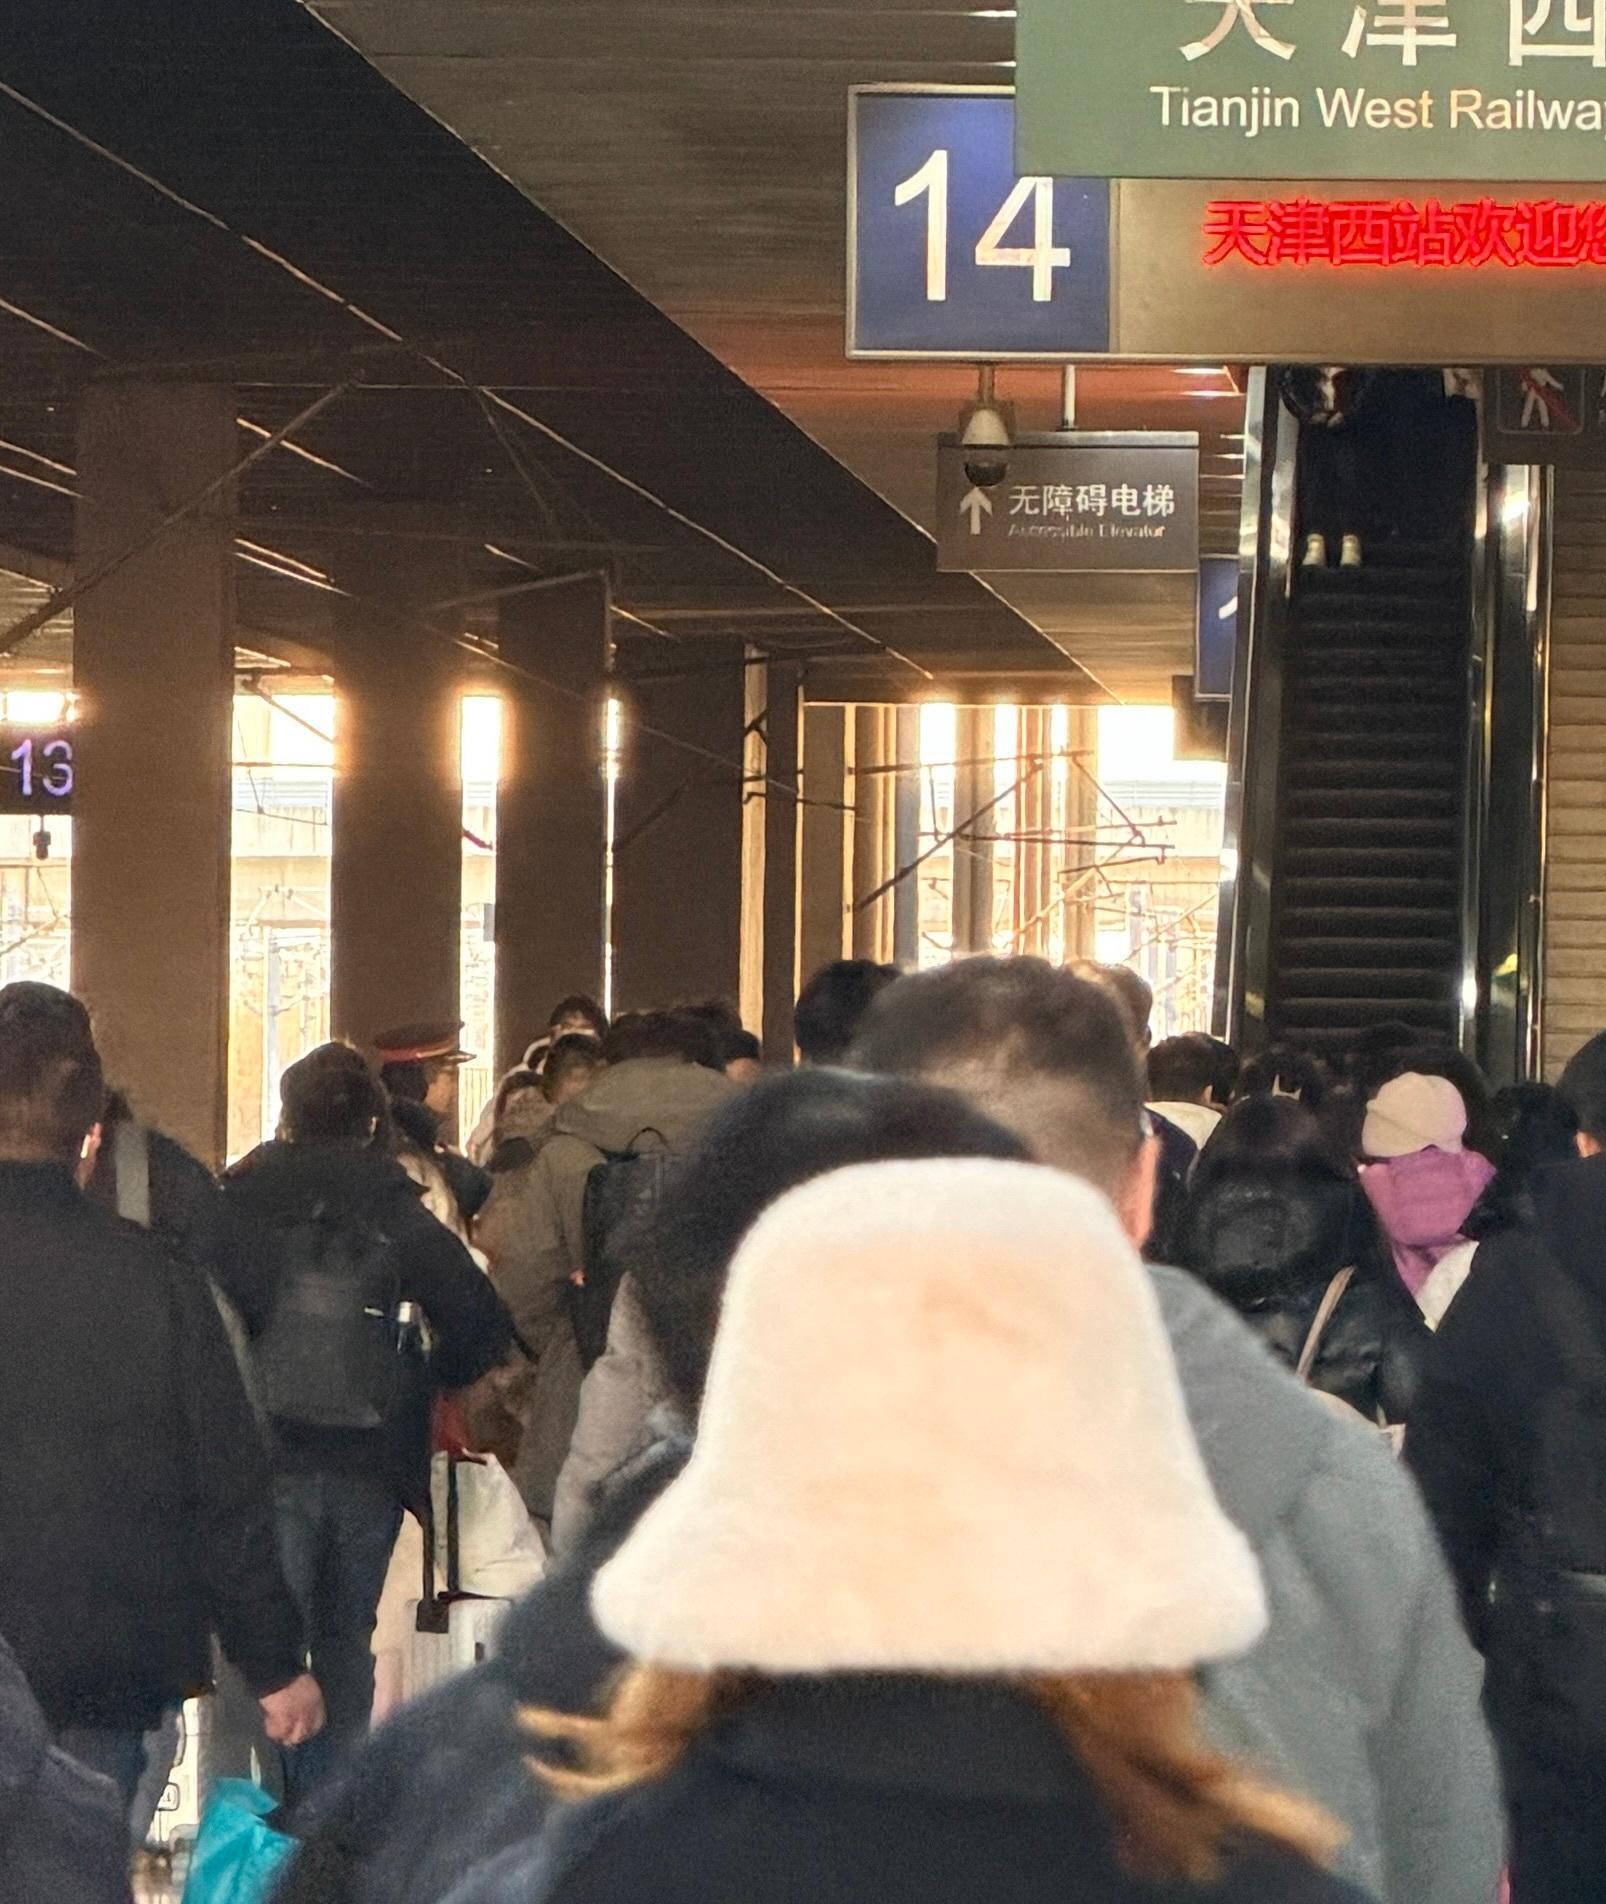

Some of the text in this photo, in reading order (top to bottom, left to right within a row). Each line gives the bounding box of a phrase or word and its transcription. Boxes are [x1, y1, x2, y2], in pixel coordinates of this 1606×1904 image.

[1149, 86, 1300, 138] Tianjin
[1315, 86, 1434, 129] West
[894, 148, 1072, 302] 14
[1008, 483, 1176, 518] 无障碍电梯
[11, 739, 73, 796] 13
